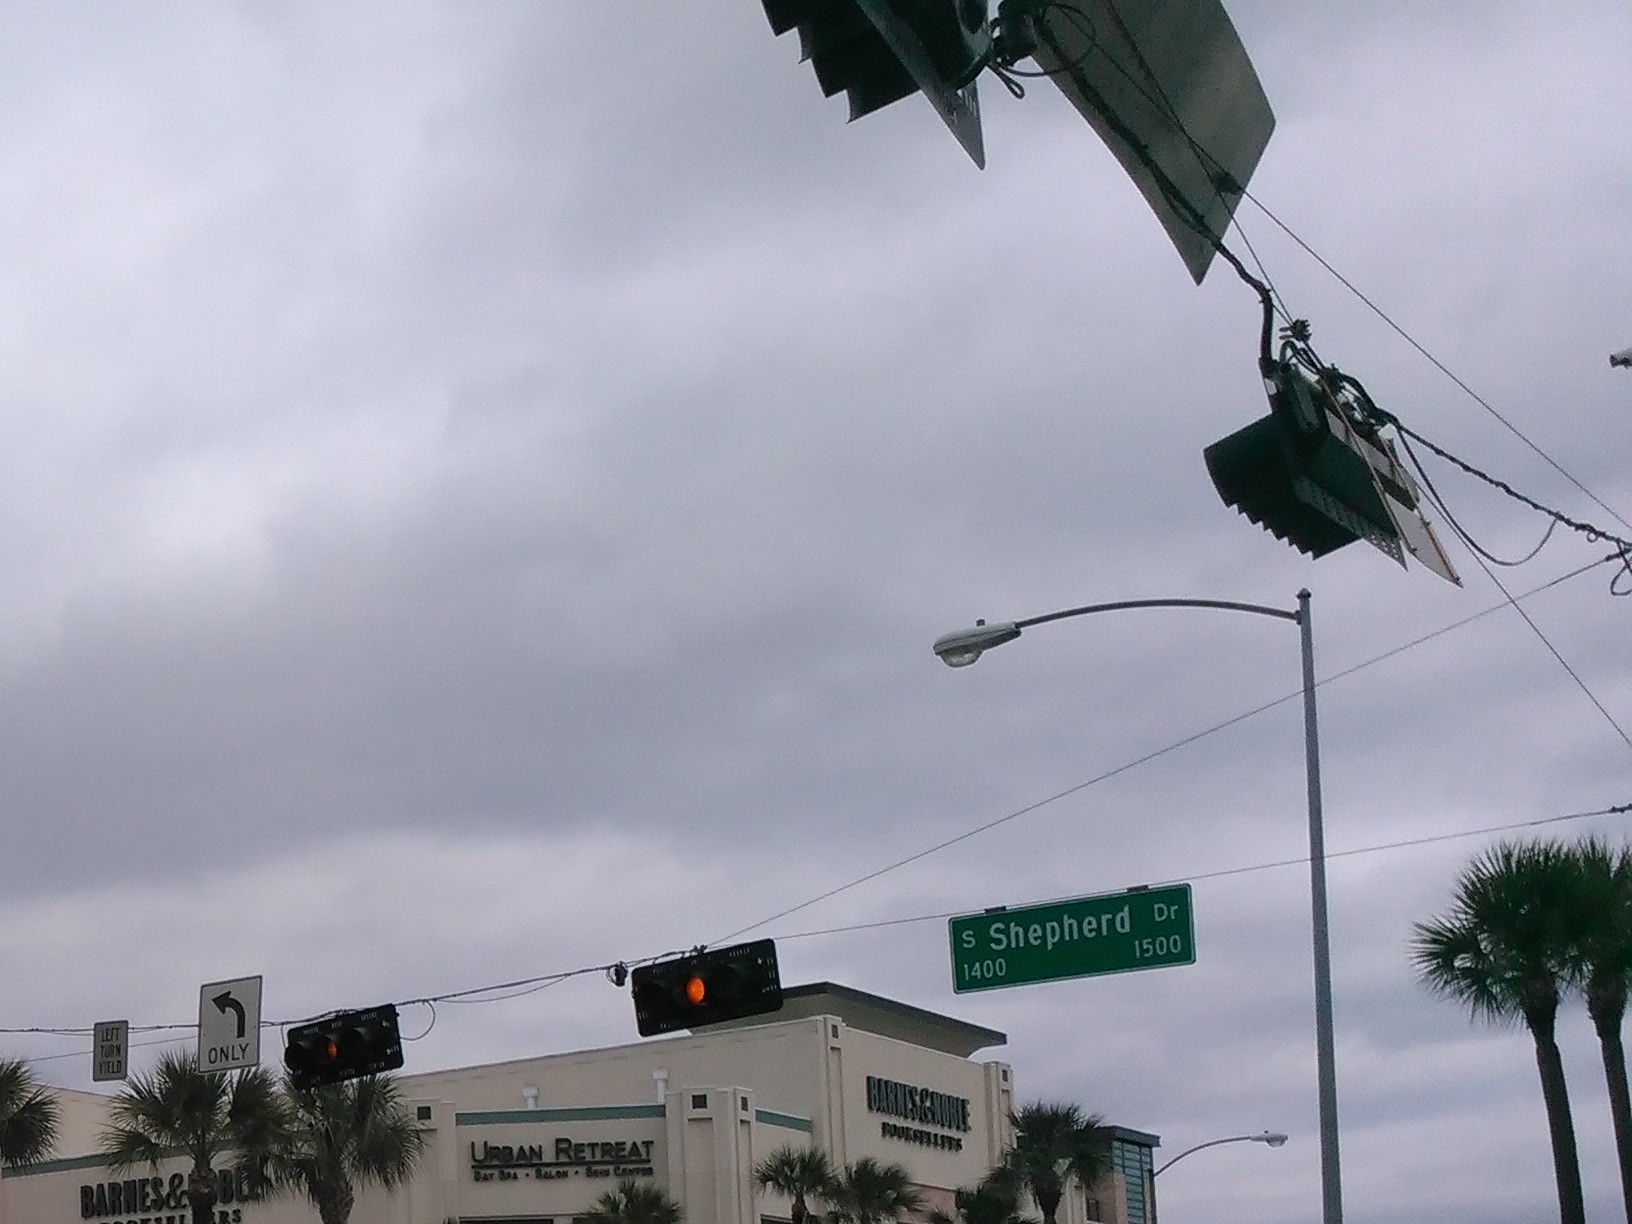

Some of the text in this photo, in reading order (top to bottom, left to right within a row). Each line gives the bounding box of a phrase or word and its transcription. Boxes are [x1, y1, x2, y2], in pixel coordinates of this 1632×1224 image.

[961, 902, 1179, 951] S Shepherd Dr
[963, 933, 1182, 981] 1400 1500
[100, 1027, 121, 1043] LEFT
[100, 1044, 121, 1059] TURN
[208, 1043, 250, 1065] ONLY
[98, 1060, 122, 1075] YIELD
[80, 1176, 164, 1219] BARNES
